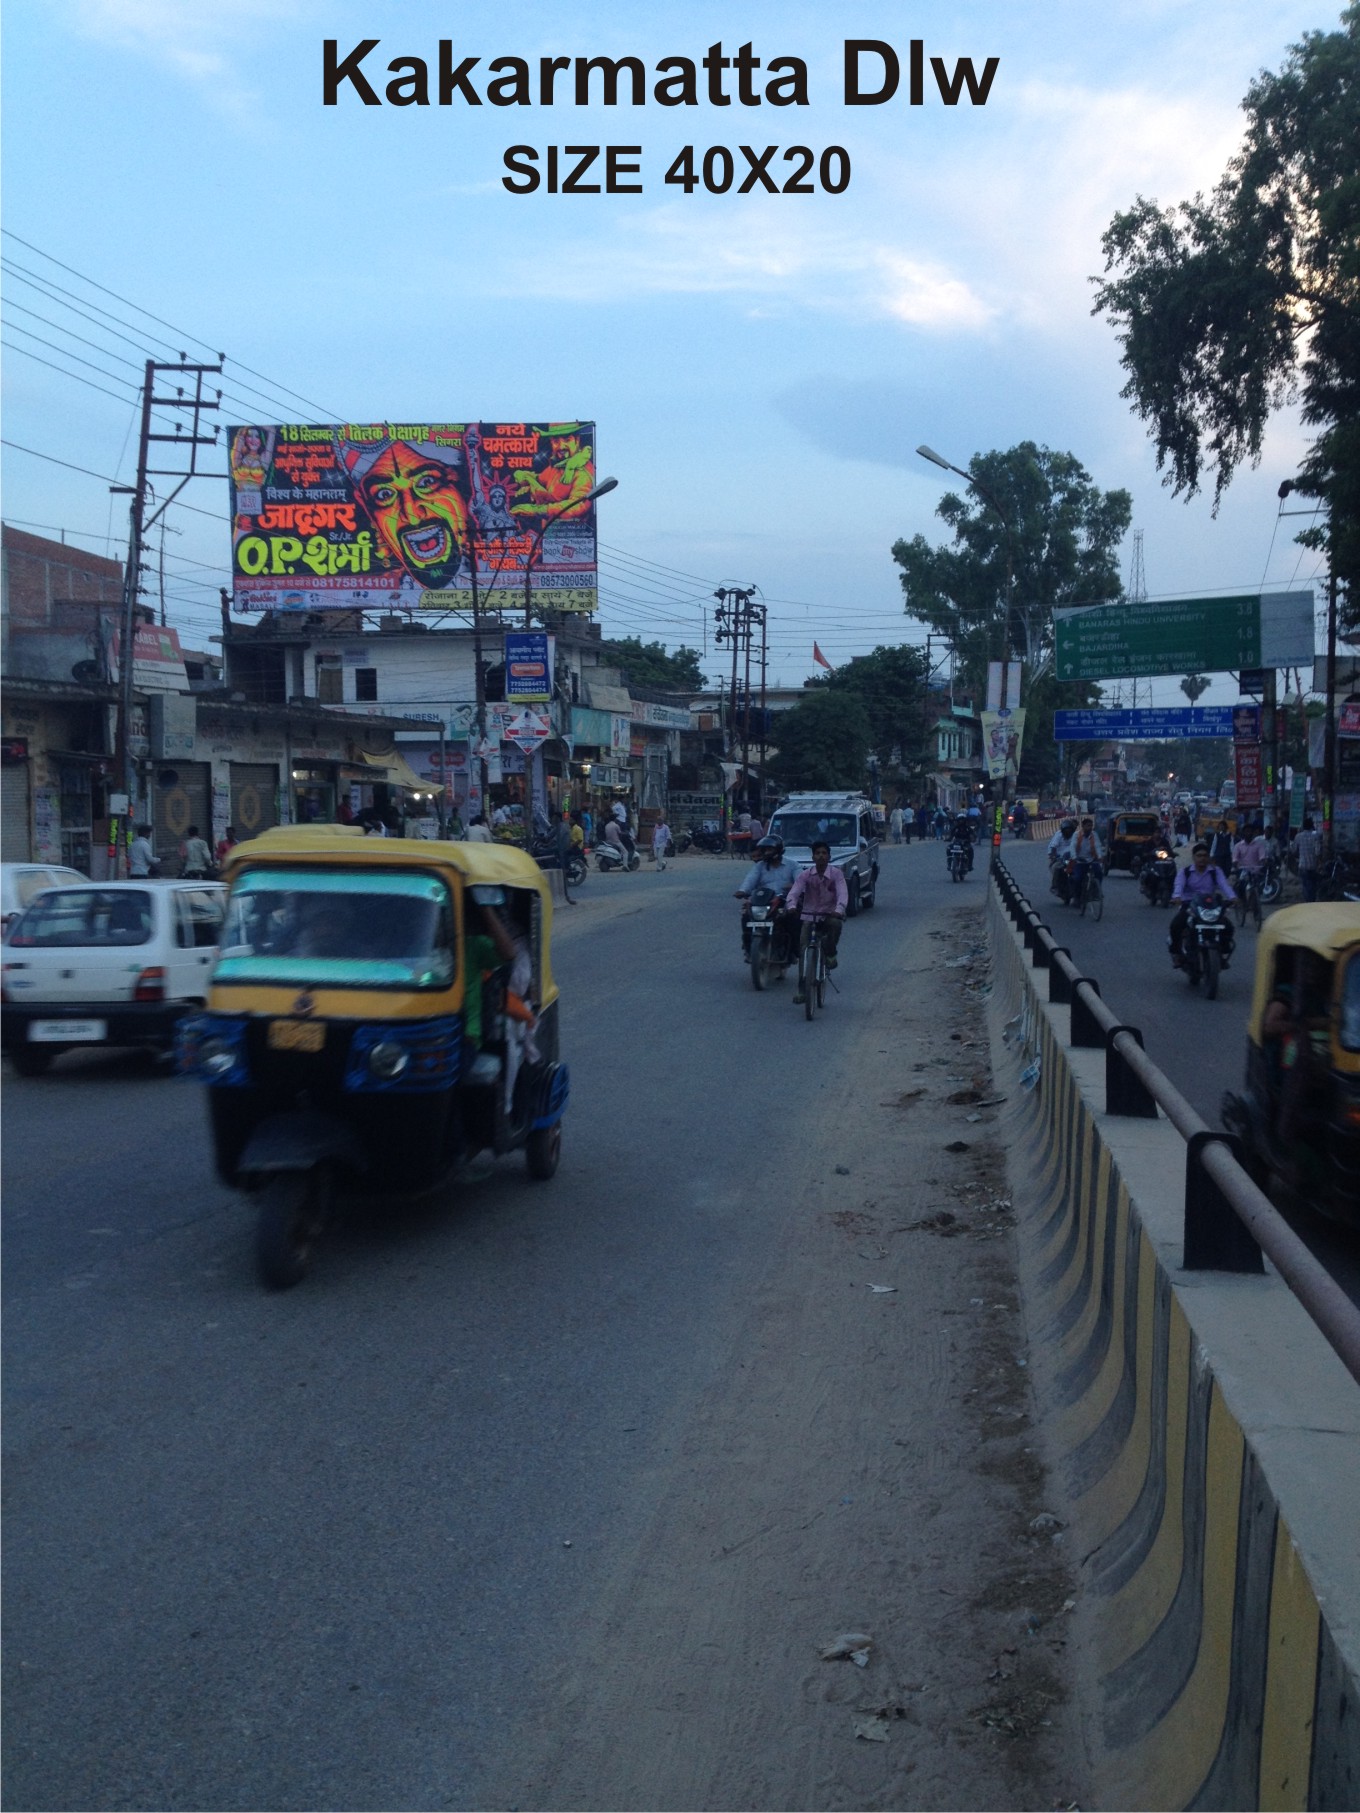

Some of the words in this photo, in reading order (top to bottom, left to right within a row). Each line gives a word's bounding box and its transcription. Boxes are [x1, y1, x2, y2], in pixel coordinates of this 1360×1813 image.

[281, 424, 299, 441] 18
[490, 455, 504, 468] के
[507, 457, 533, 469] साथ
[293, 486, 305, 500] के
[257, 503, 358, 536] जादूगर
[302, 531, 373, 576] शर्मा
[312, 578, 395, 588] 08175814101
[462, 591, 470, 600] 2
[500, 591, 507, 599] 2
[566, 590, 573, 599] 7
[453, 600, 462, 609] 3
[569, 600, 577, 609] 7
[1237, 602, 1253, 616] 3.8
[1079, 619, 1121, 629] BANARAS
[1124, 616, 1150, 625] HINDU
[1153, 613, 1206, 624] UNIVERSITY
[1238, 627, 1254, 640] 1.8
[1238, 651, 1254, 664] 1.0
[1080, 667, 1109, 677] DIESEL
[1113, 662, 1168, 674] LOCOMOTIVE
[1172, 661, 1206, 670] WORKS
